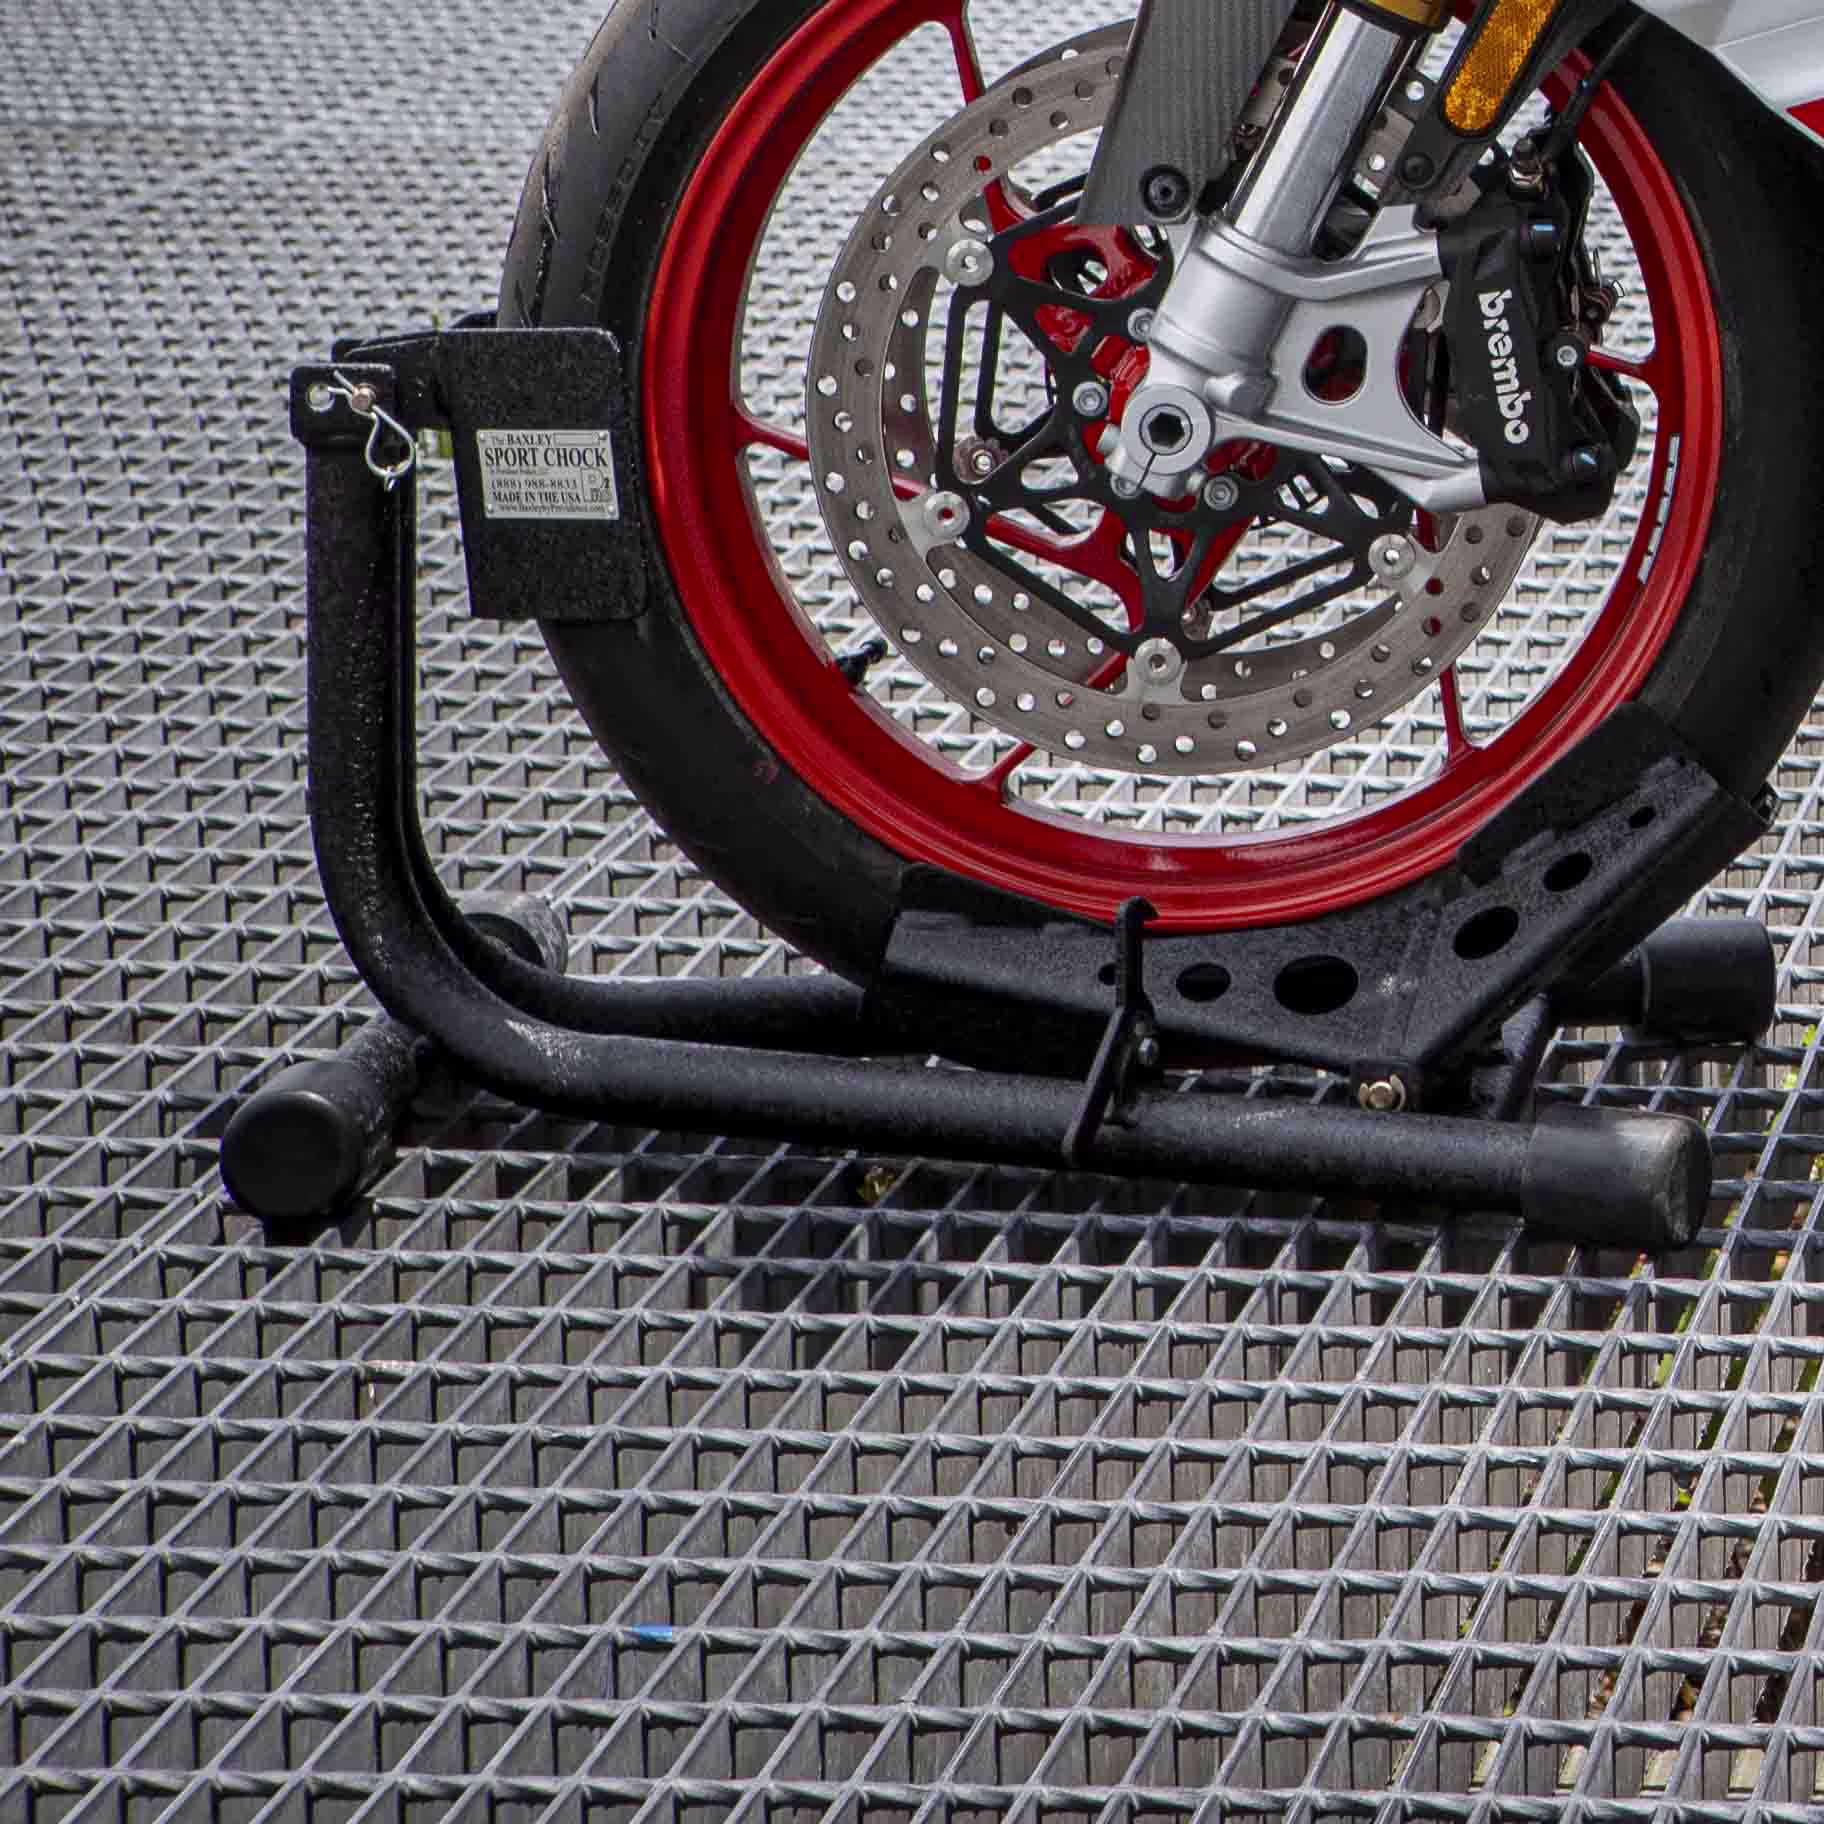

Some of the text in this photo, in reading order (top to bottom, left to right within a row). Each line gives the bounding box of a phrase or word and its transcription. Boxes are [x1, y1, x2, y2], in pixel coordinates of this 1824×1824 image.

[1478, 288, 1531, 444] brembo
[507, 433, 552, 446] BAXLEY
[484, 447, 609, 467] SPORT CHOCK
[493, 491, 582, 503] MADE IN THE USA
